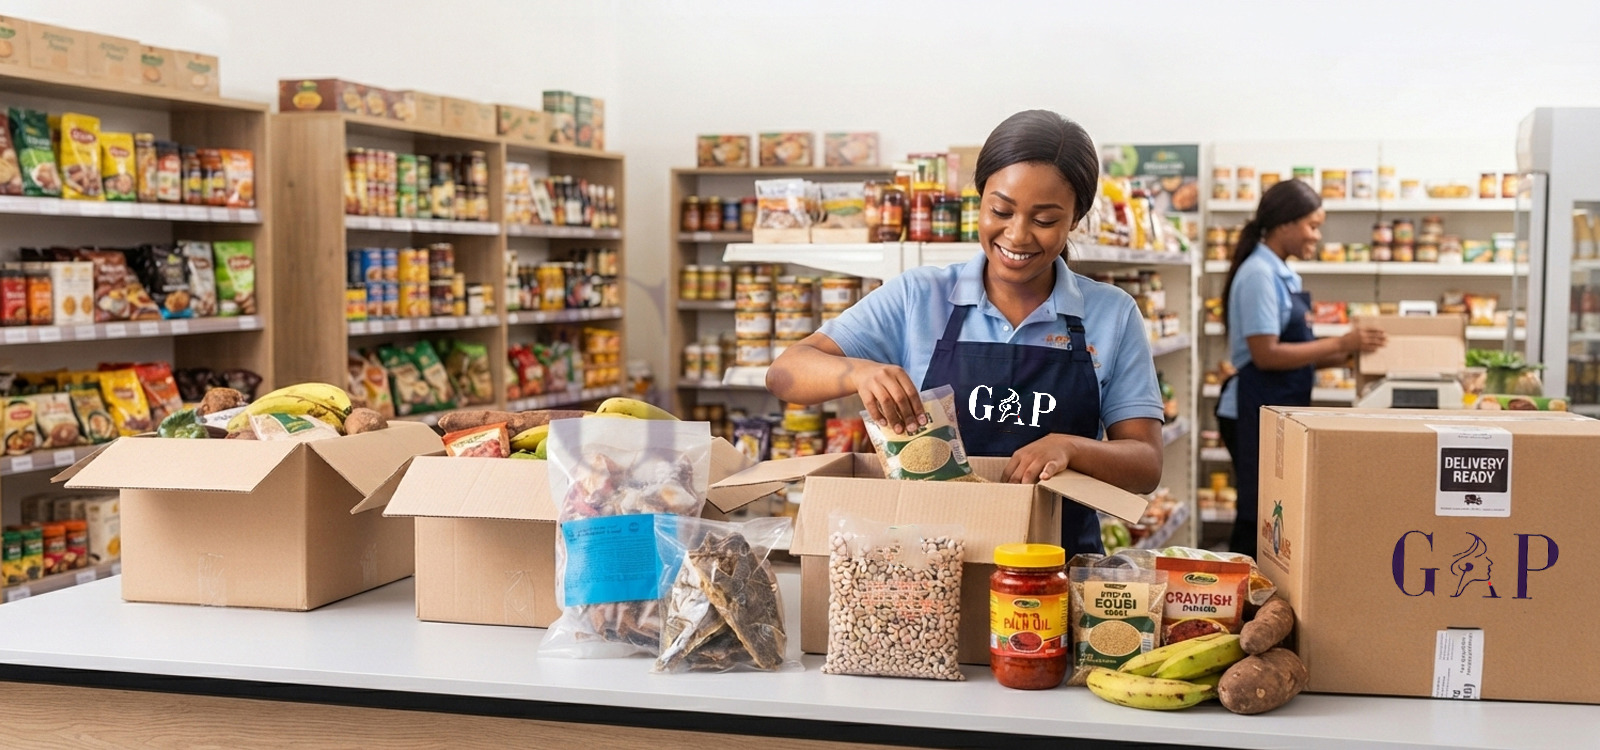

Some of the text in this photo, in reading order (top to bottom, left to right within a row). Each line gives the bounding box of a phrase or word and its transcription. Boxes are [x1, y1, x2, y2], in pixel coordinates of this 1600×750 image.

[968, 384, 1057, 428] GAP
[1444, 456, 1505, 470] DELIVERY
[1452, 470, 1496, 484] READY
[1391, 529, 1560, 600] GAP
[1165, 591, 1233, 607] CRAYFISH
